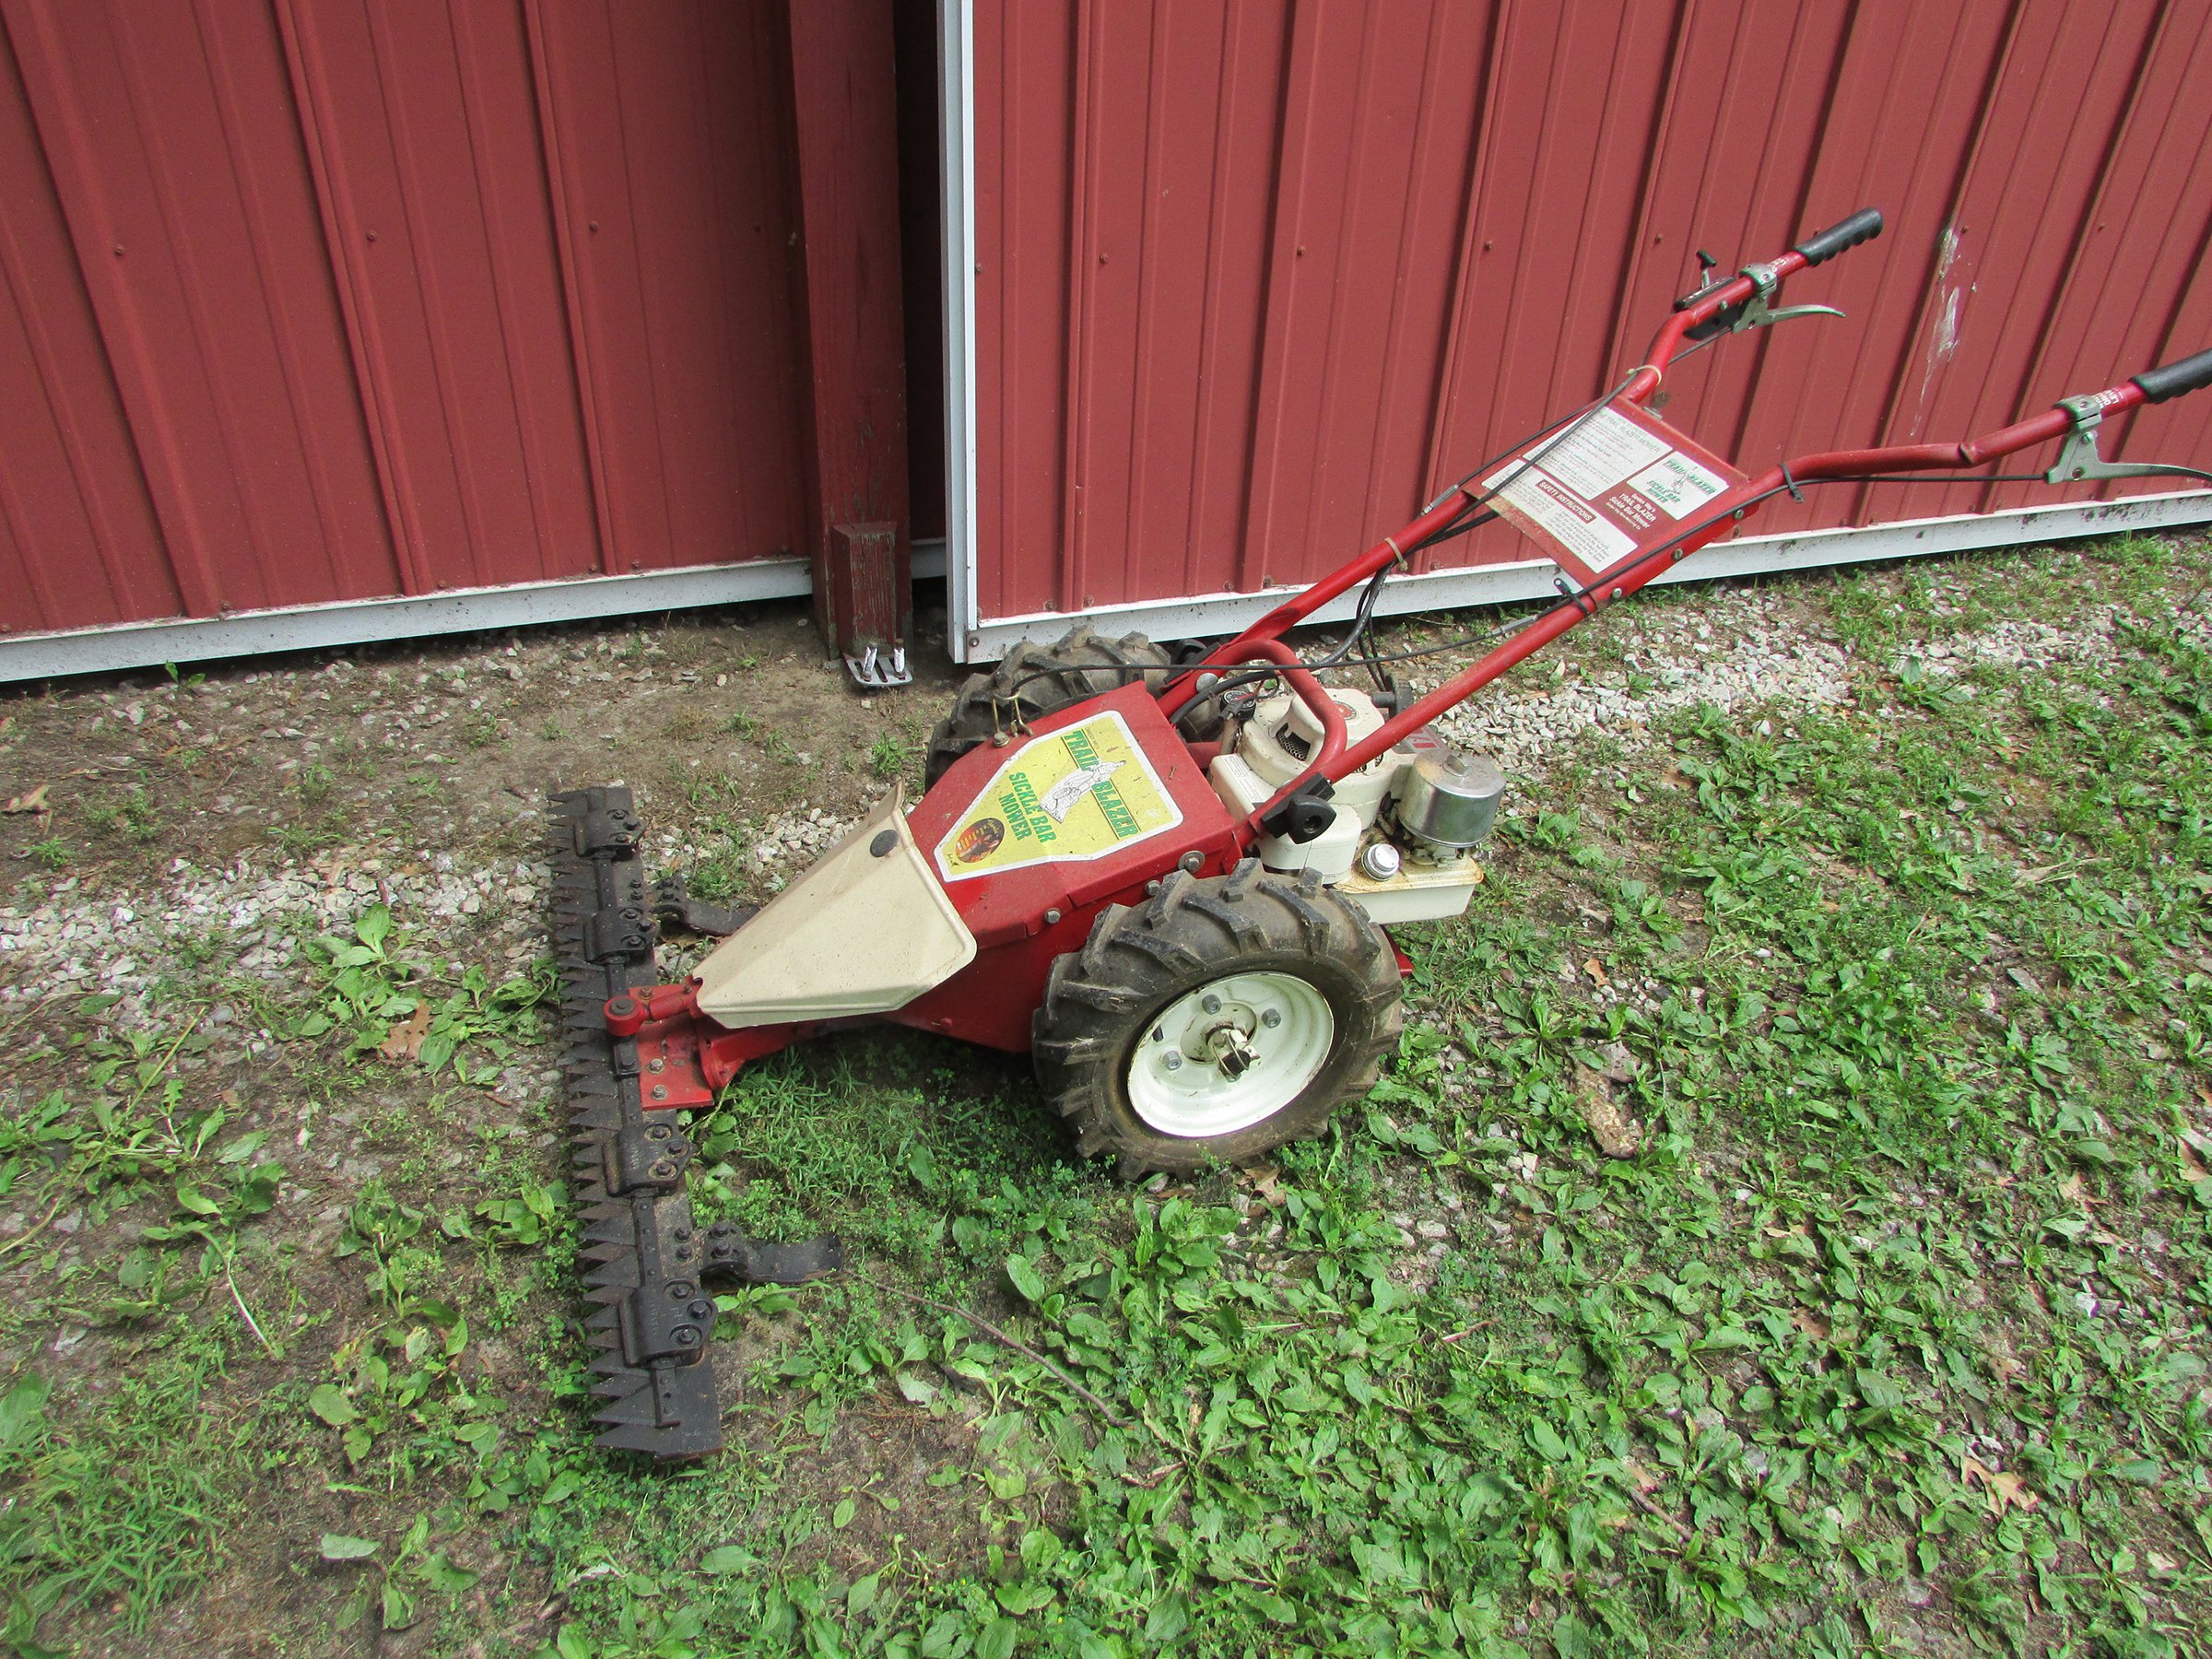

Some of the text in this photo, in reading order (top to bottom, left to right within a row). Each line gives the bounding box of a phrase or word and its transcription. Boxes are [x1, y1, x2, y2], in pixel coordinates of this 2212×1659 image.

[1539, 481, 1559, 496] SAFETY
[1557, 493, 1592, 521] INSTRUCTIONS
[1609, 496, 1651, 528] Sickle Bar Mower
[1618, 493, 1656, 523] TRAIL BLAZER
[1064, 730, 1139, 839] TRAIL BLAZER
[997, 792, 1032, 841] MOWER
[1008, 771, 1057, 843] SICKLE BAR
